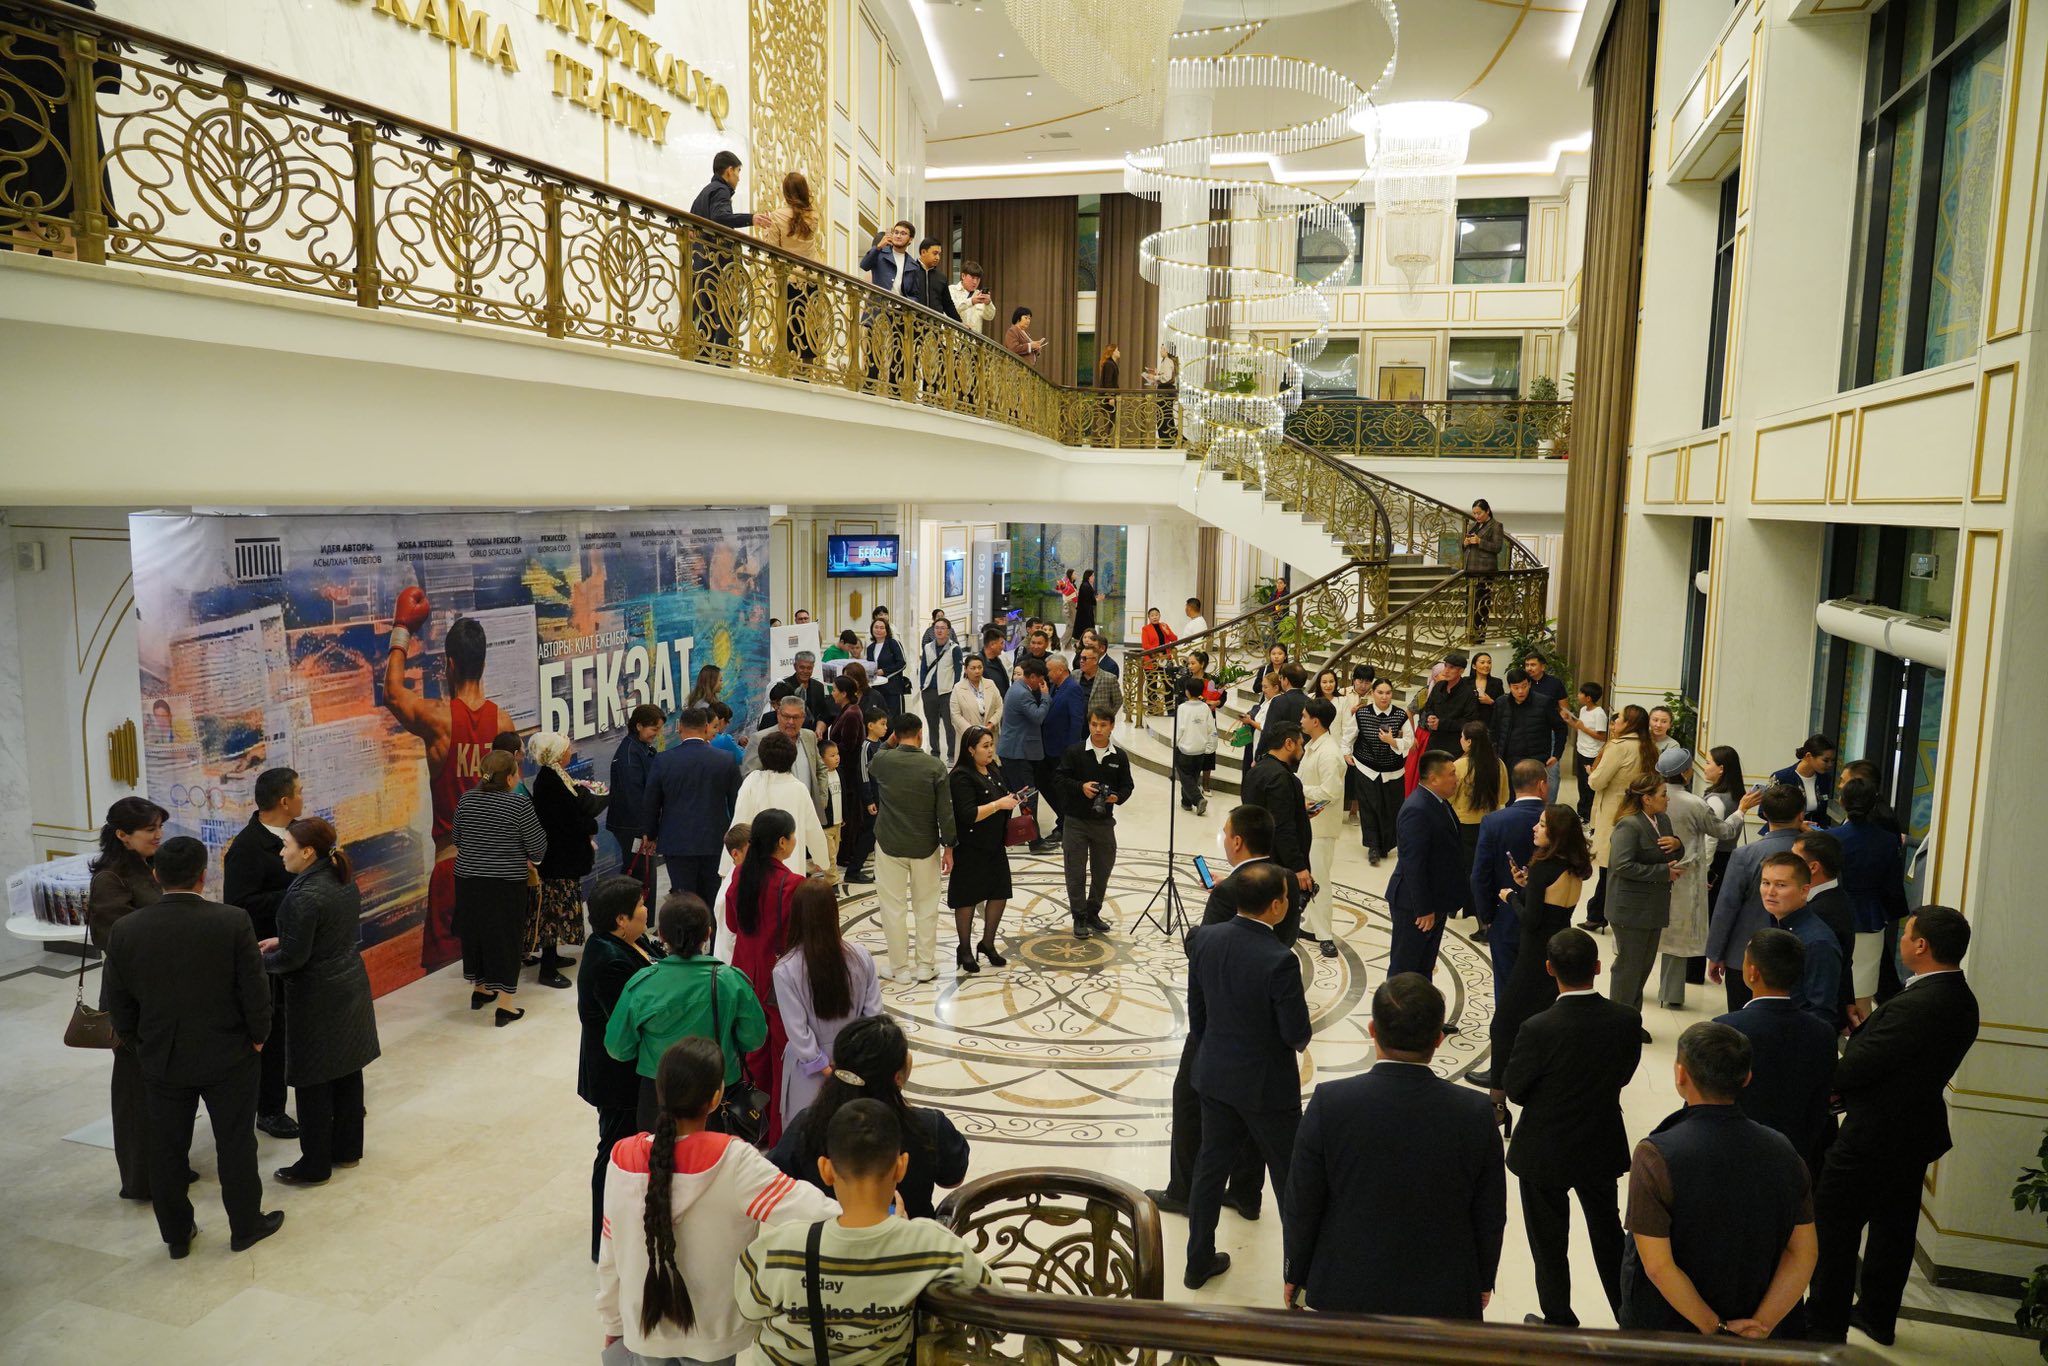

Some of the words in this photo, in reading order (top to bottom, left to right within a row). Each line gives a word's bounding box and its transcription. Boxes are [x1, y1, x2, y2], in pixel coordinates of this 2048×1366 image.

[546, 49, 672, 146] TEATRY
[493, 536, 523, 545] РЕЖИССЕР:
[540, 534, 568, 542] РЕЖИССЕР:
[320, 544, 341, 555] ИДЕЯ
[341, 543, 375, 553] АВТОРЫ:
[397, 541, 417, 549] ЖОБА
[557, 544, 571, 552] COCO
[469, 550, 488, 558] CARLO
[858, 546, 893, 559] БЕКЗАТ
[313, 558, 348, 568] АСЫЛХАН
[349, 556, 382, 566] ТӨЛЕПОВ
[978, 553, 986, 571] GO
[978, 574, 985, 591] TO
[538, 639, 574, 660] АВТОРЫ:
[539, 636, 694, 741] БЕКЗАТ
[800, 1276, 844, 1294] tday
[821, 1303, 856, 1320] he
[827, 1327, 844, 1341] be
